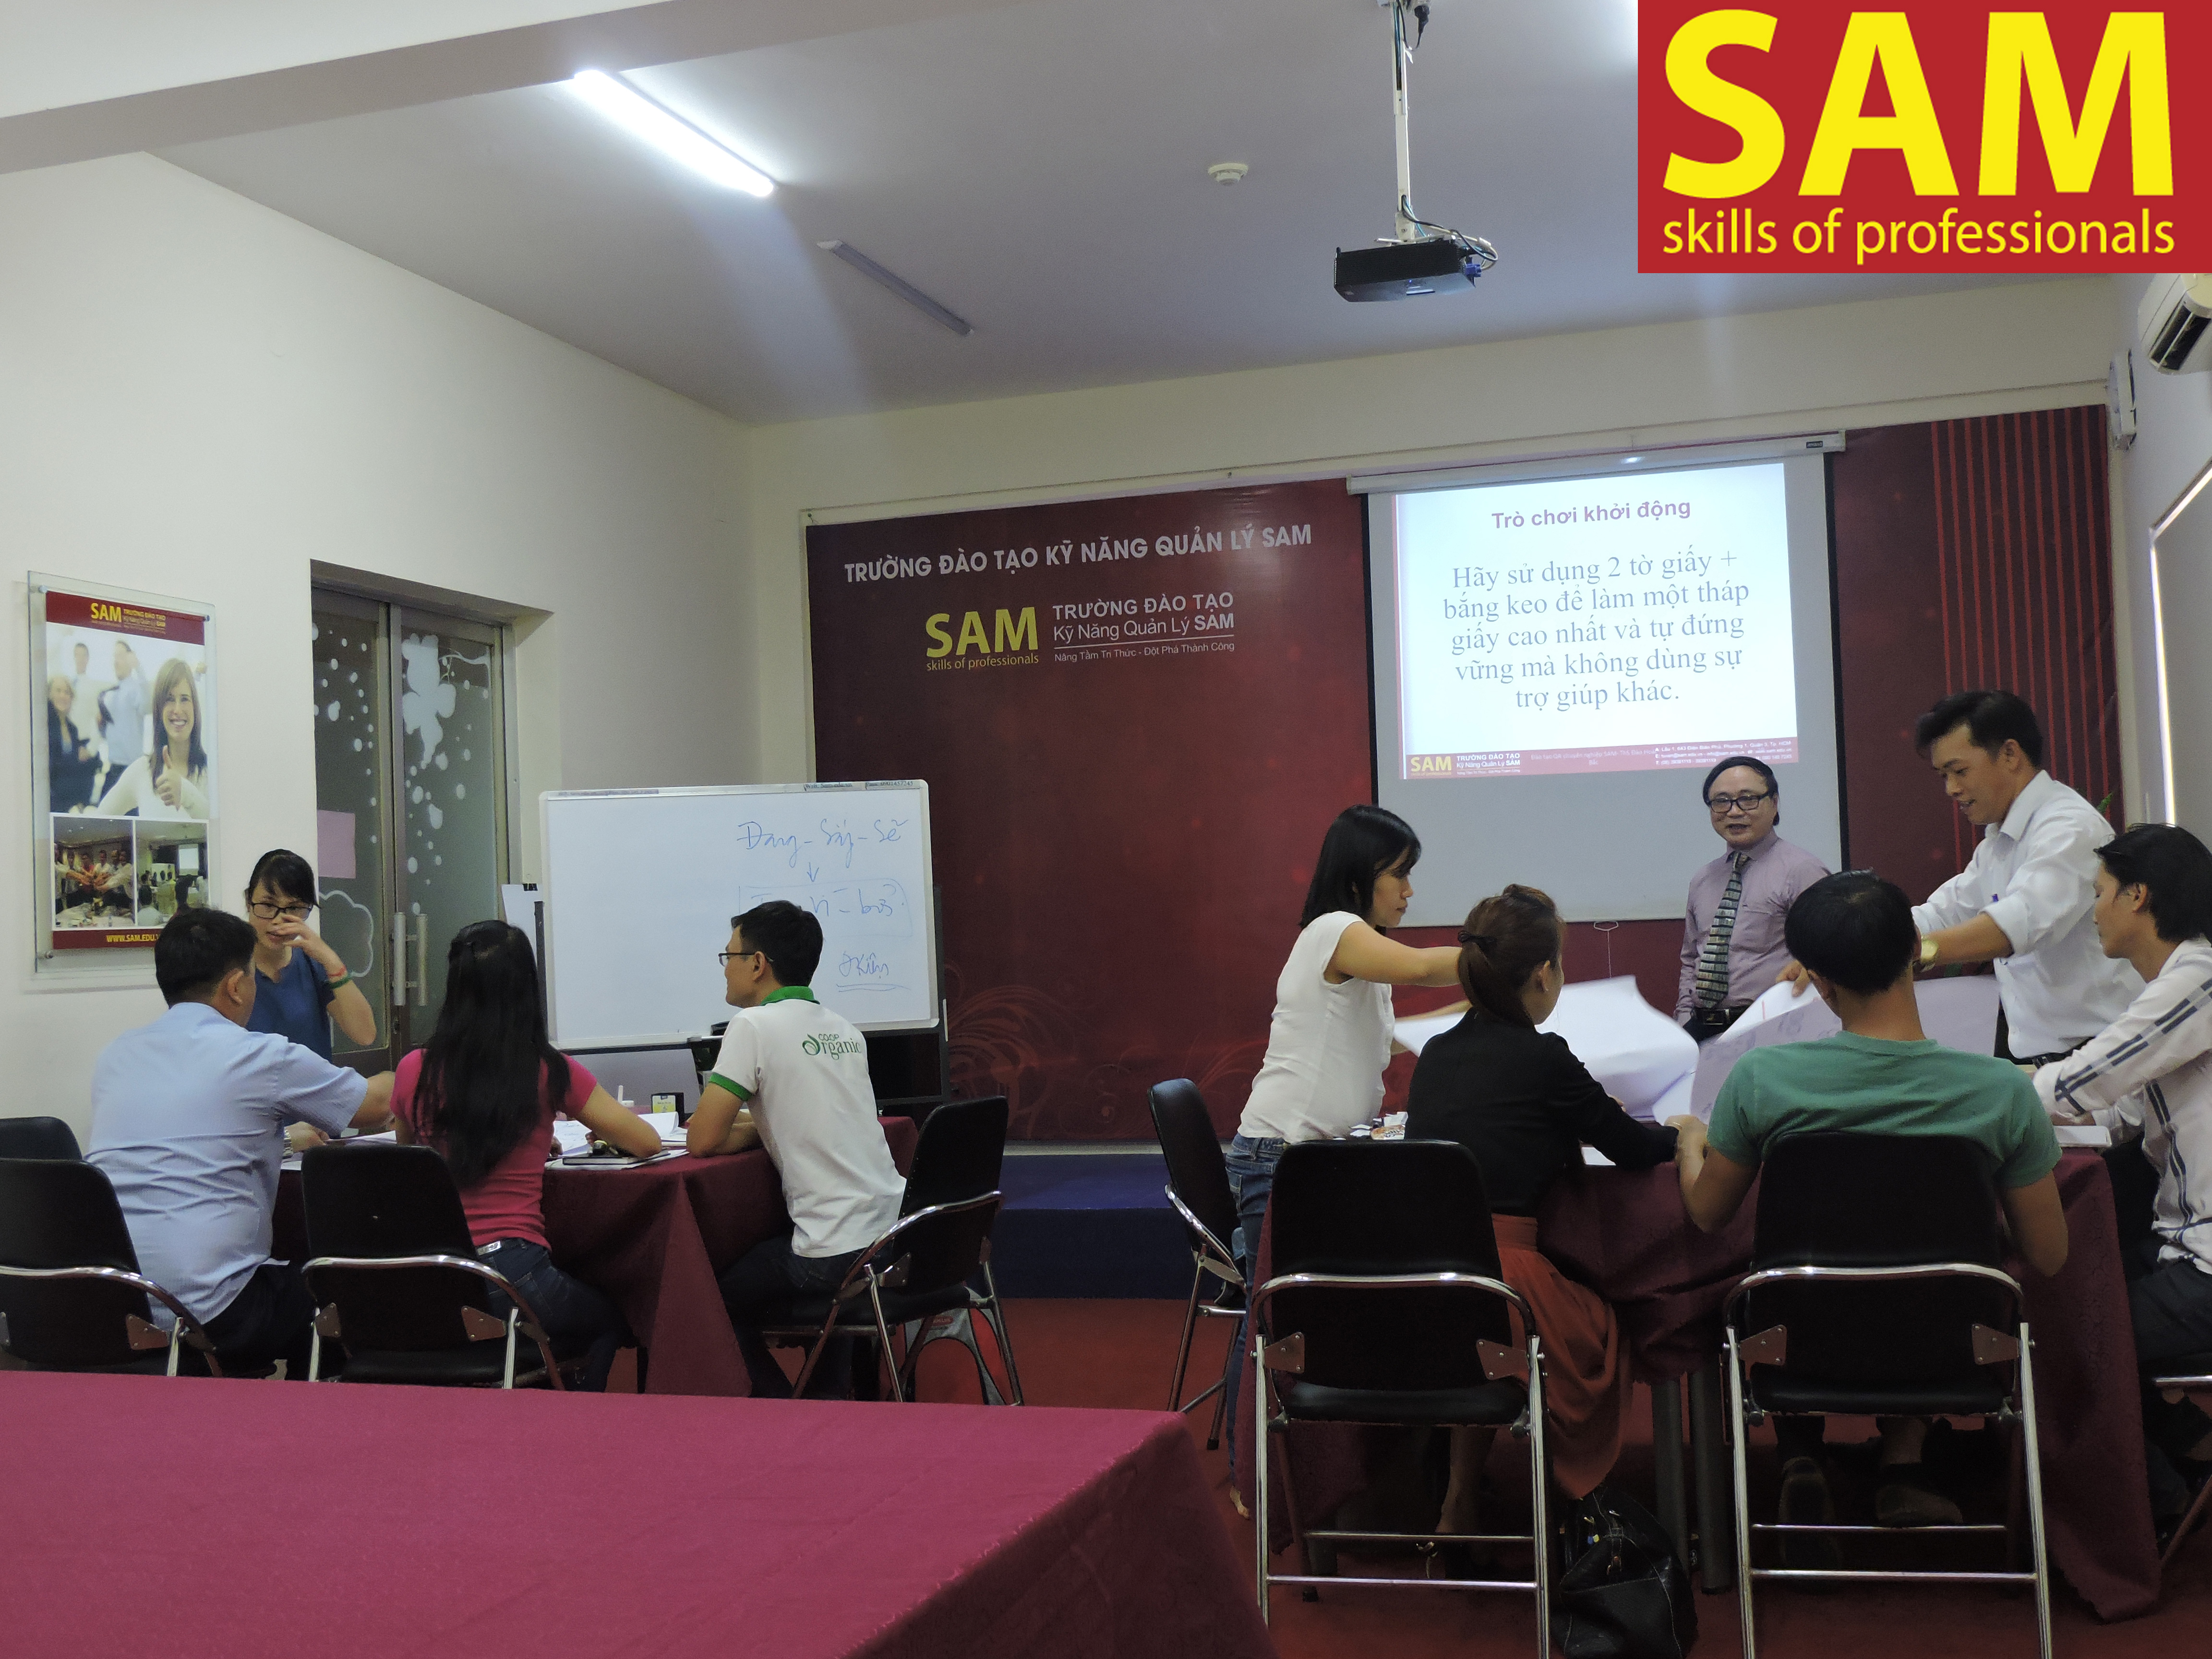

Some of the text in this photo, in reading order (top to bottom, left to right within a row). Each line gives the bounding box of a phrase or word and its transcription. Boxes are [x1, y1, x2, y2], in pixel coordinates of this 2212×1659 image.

[1491, 500, 1691, 529] Trò chơi khởi động
[844, 523, 1311, 582] TRƯỜNG ĐÀO TẠO KỸ NĂNG QUẢN LÝ SAM
[1453, 544, 1737, 591] Hãy sử dụng 2 tờ giấy +
[1052, 592, 1233, 620] TRƯỜNG ĐÀO TẠO
[1506, 594, 1547, 614] keo
[1556, 584, 1583, 612] để
[1591, 588, 1635, 609] làm
[1643, 584, 1689, 609] một
[1697, 580, 1749, 606] tháp
[91, 603, 122, 623] SAM
[1054, 613, 1234, 644] Kỹ Năng Quản Lý SAM
[926, 607, 1038, 658] SAM
[1452, 613, 1744, 655] giấy cao nhất và tự đứng
[927, 653, 1038, 671] skills of professionals
[1055, 653, 1077, 662] Nâng
[1211, 641, 1235, 652] Công
[1455, 648, 1742, 684] vững mà không dùng sự
[1516, 679, 1679, 711] trợ giúp khác.
[1411, 756, 1452, 772] SAM
[802, 1033, 862, 1060] Organic
